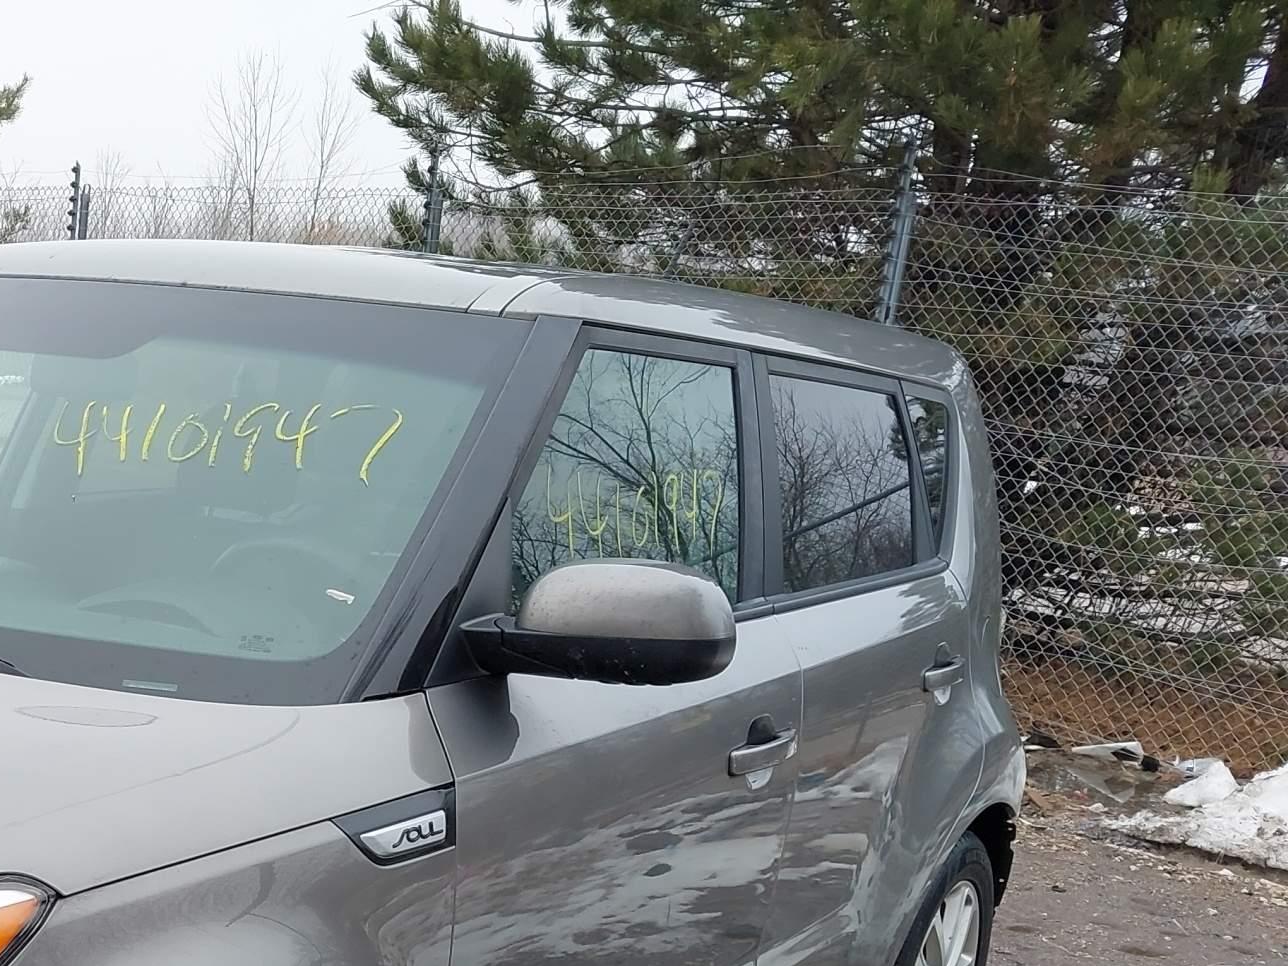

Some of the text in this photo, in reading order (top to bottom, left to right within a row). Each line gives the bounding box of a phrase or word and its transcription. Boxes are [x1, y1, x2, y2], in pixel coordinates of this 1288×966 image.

[53, 400, 404, 487] 44101947
[546, 463, 723, 558] 44101947
[391, 820, 444, 849] SOUL
